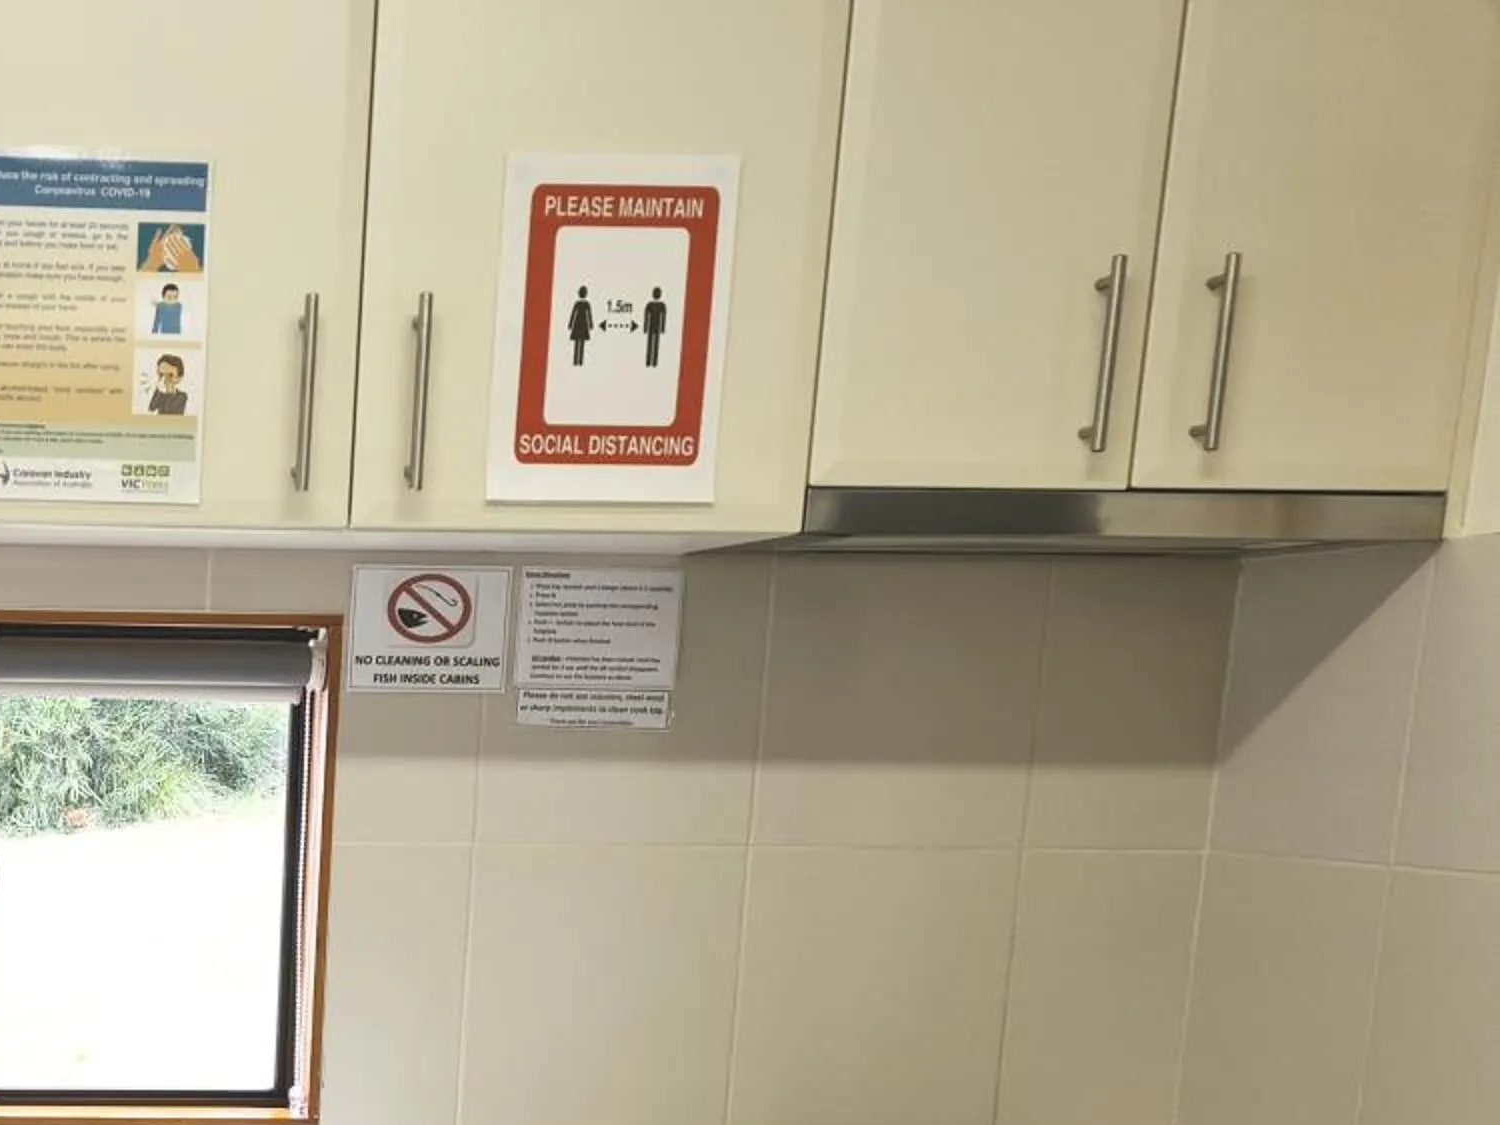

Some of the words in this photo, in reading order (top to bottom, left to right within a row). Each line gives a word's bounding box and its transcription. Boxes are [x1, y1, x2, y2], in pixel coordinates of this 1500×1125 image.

[22, 168, 37, 180] the
[40, 172, 58, 182] risk
[73, 173, 131, 186] contracting
[134, 174, 153, 184] and
[155, 175, 205, 188] spreading
[35, 184, 96, 196] Coronavirus
[101, 186, 151, 198] COVID-19
[544, 196, 615, 217] PLEASE
[618, 197, 704, 219] MAINTAIN
[606, 300, 633, 314] 1.5m
[519, 434, 584, 455] SOCIAL
[588, 435, 694, 456] DISTANCING
[355, 655, 373, 665] NO
[375, 655, 431, 667] CLEANING
[433, 655, 451, 667] OR
[453, 656, 501, 667] SCALING
[373, 673, 397, 684] FISH
[400, 673, 437, 685] INSIDE
[439, 673, 481, 685] CABINS
